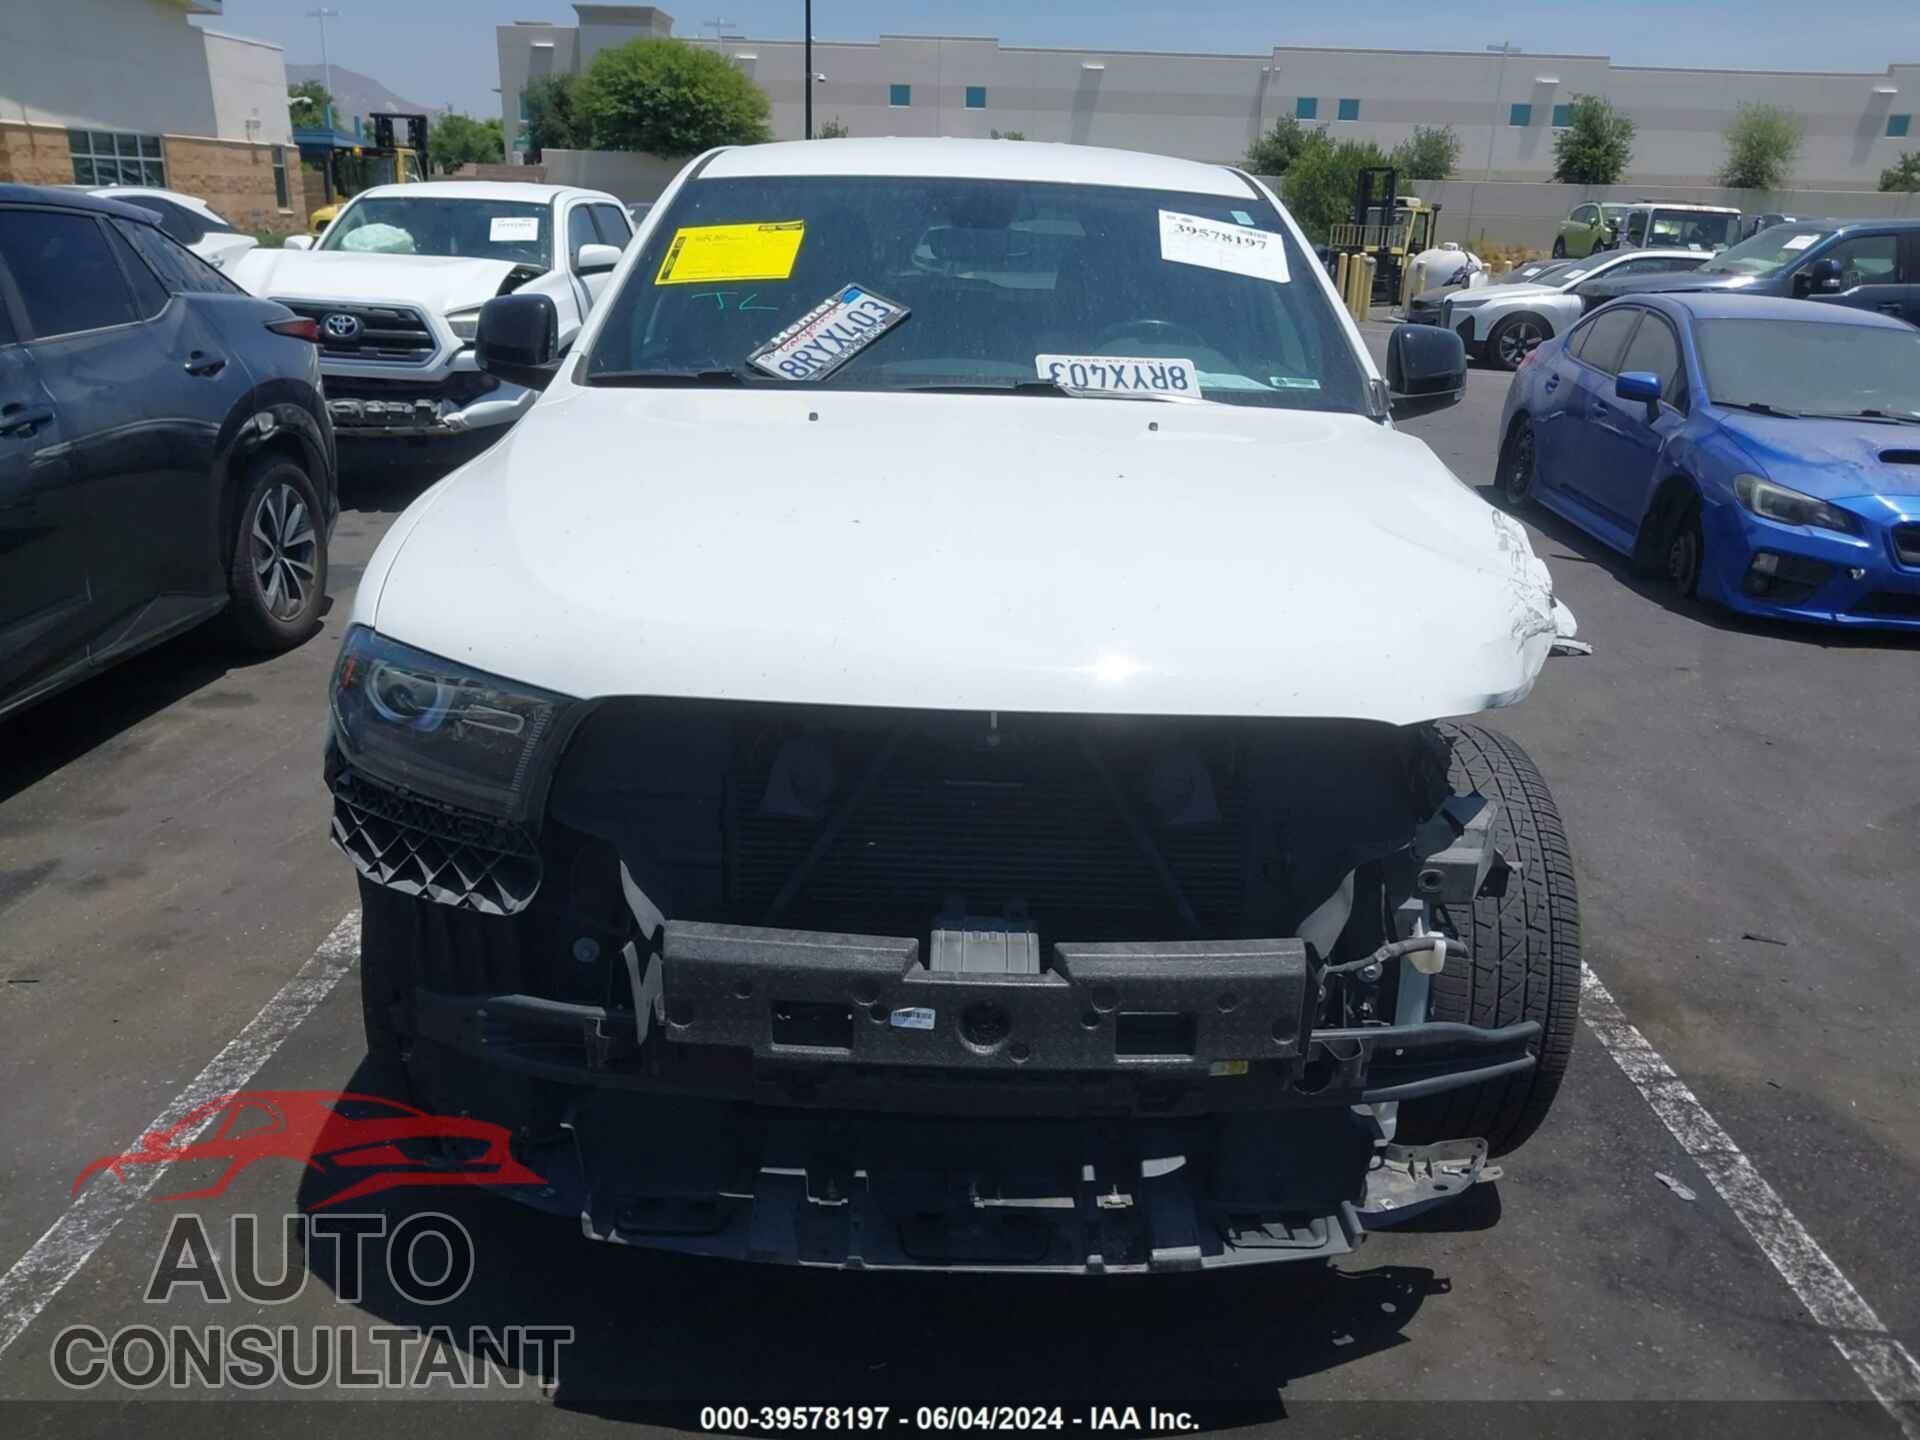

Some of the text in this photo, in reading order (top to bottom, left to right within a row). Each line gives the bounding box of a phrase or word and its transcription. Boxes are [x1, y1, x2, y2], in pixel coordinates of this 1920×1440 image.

[1173, 223, 1267, 250] 39578197
[778, 300, 891, 380] 8RYX403
[1048, 361, 1189, 391] 8RYX403
